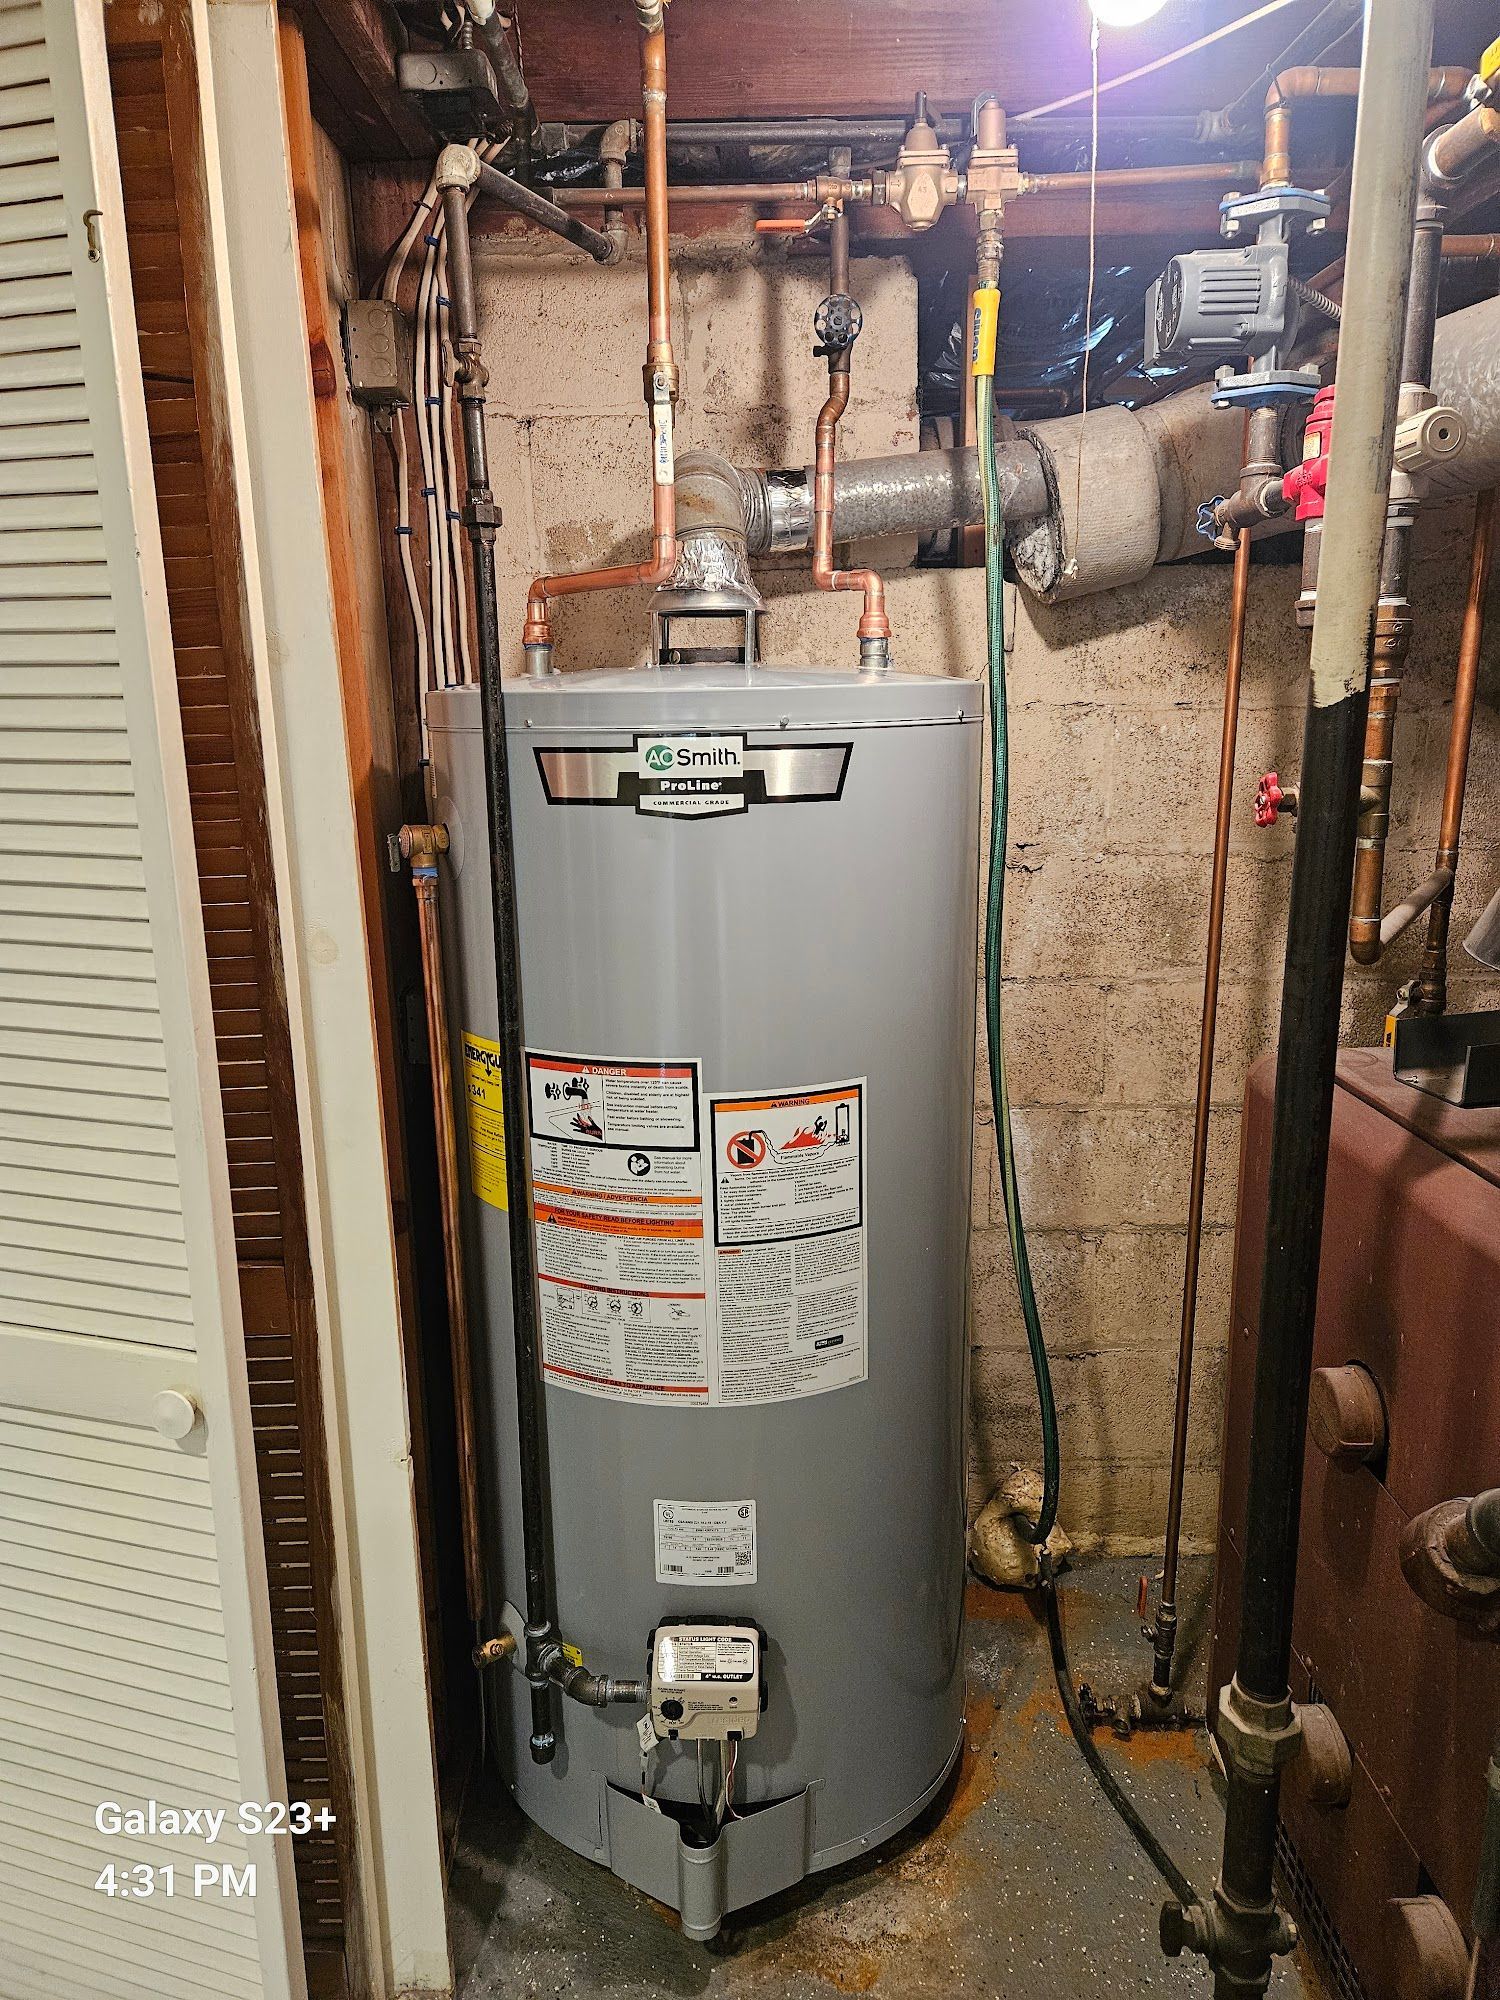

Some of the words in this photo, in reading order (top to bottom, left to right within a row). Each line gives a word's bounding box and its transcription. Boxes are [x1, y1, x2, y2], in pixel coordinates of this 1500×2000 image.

[592, 1068, 627, 1076] DANGER
[777, 1098, 810, 1108] WARNING
[606, 1194, 648, 1202] ADVERTENCIA
[565, 1209, 580, 1218] YOUR
[581, 1211, 603, 1220] SAFETY
[603, 1215, 620, 1223] READ
